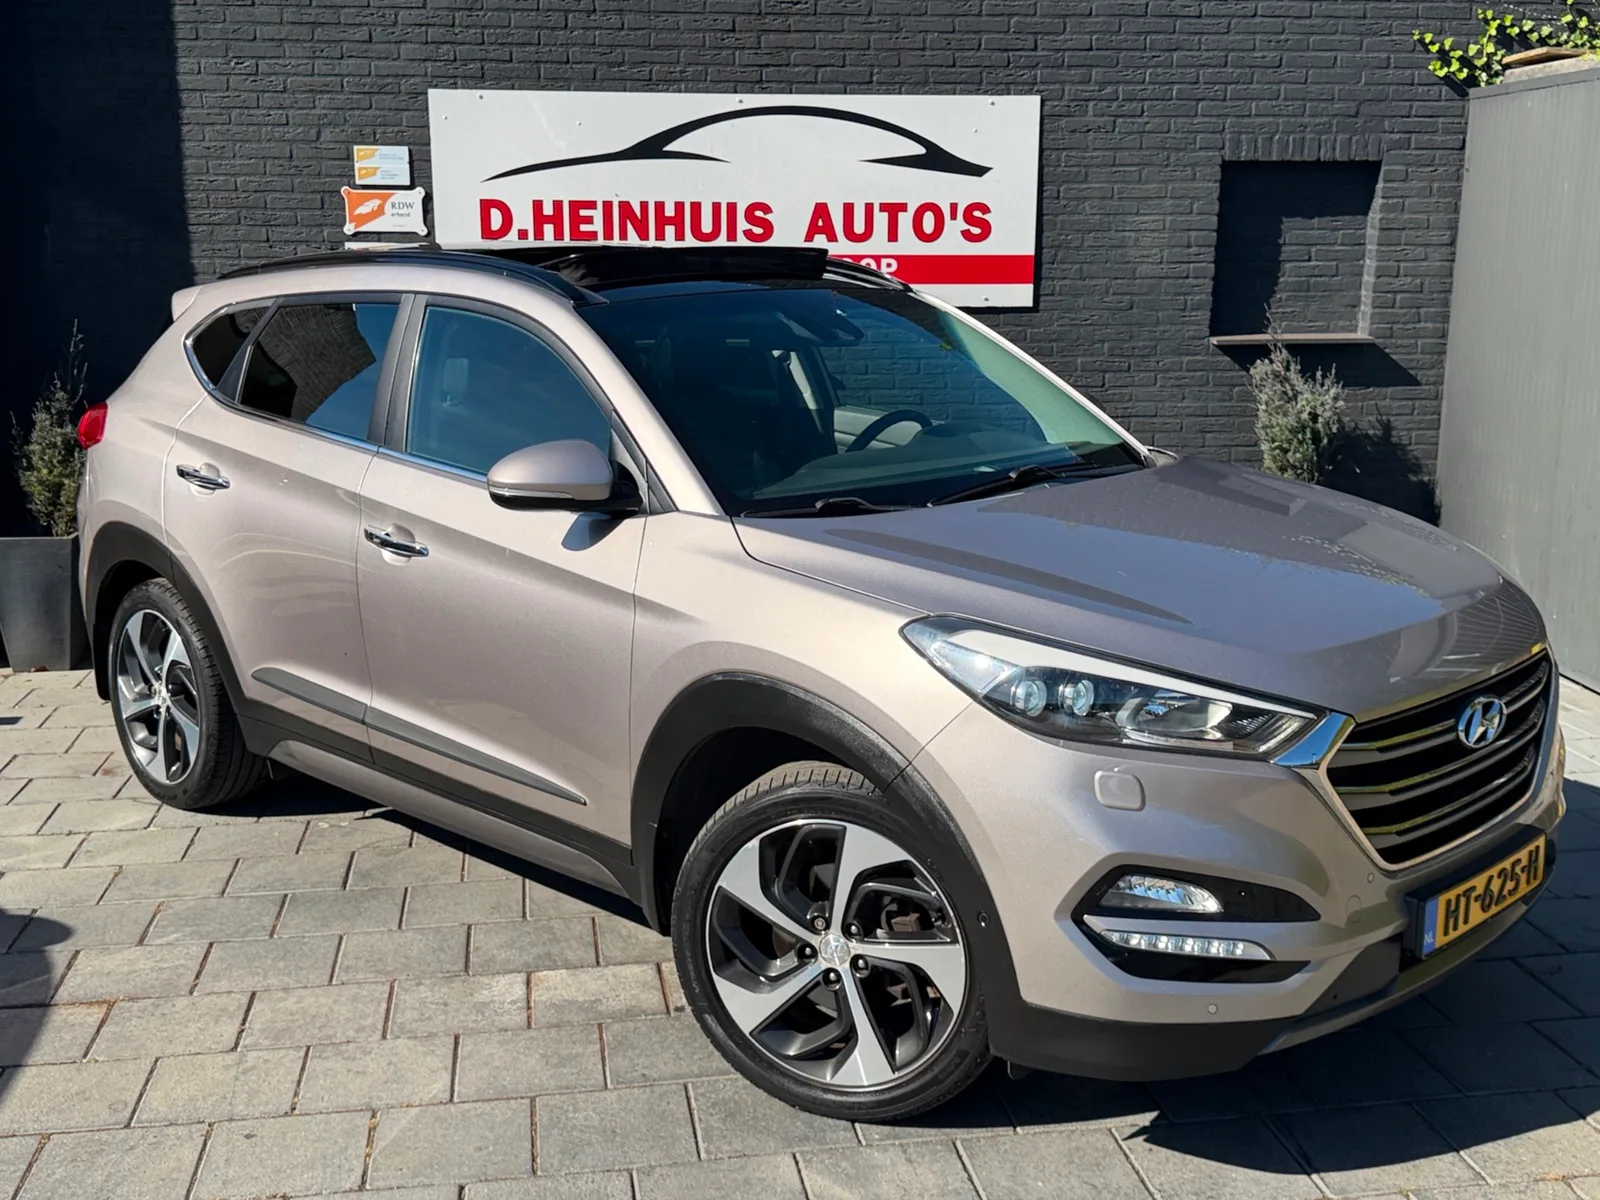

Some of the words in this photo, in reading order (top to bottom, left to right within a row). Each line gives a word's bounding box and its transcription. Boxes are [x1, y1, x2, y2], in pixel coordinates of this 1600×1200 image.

[391, 201, 415, 210] RDW
[479, 198, 775, 242] D.HEINHUIS
[803, 201, 993, 244] AUTO'S
[1443, 845, 1540, 937] HT-625-H
[1424, 931, 1434, 946] NL
